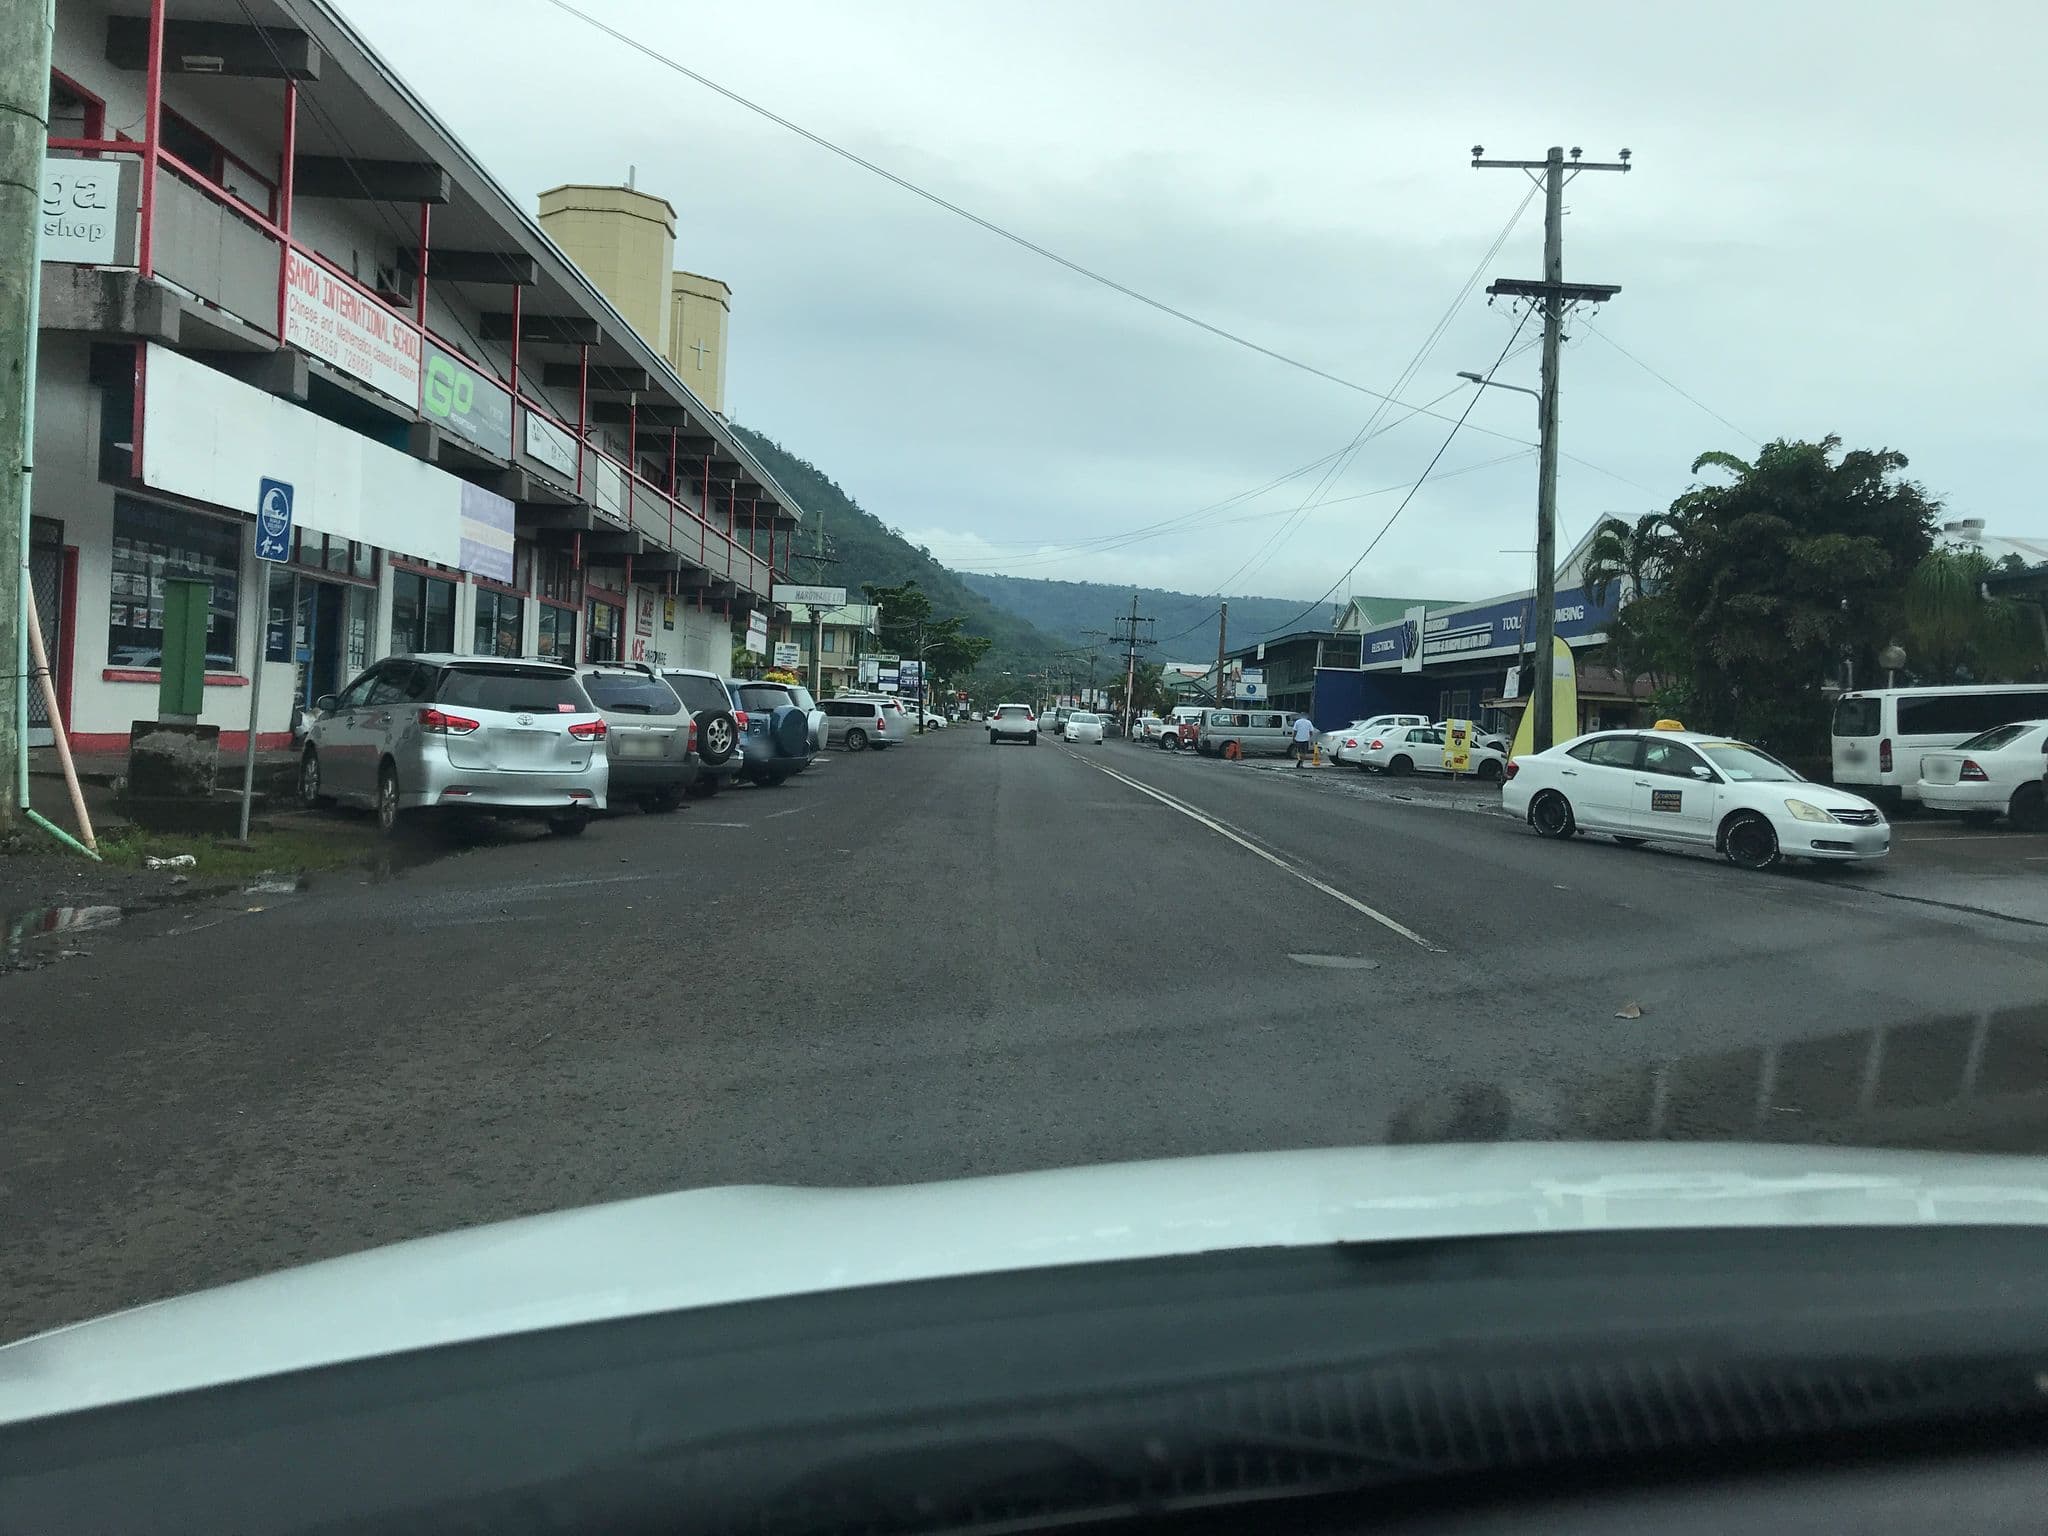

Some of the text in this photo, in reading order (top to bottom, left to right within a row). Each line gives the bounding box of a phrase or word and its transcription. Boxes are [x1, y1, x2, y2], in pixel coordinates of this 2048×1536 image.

[44, 218, 106, 242] shop
[286, 255, 320, 301] SAMOA
[322, 276, 391, 345] INTERNATIONAL
[393, 323, 420, 364] SCHOOL
[289, 293, 318, 324] Chinese
[321, 316, 334, 333] and
